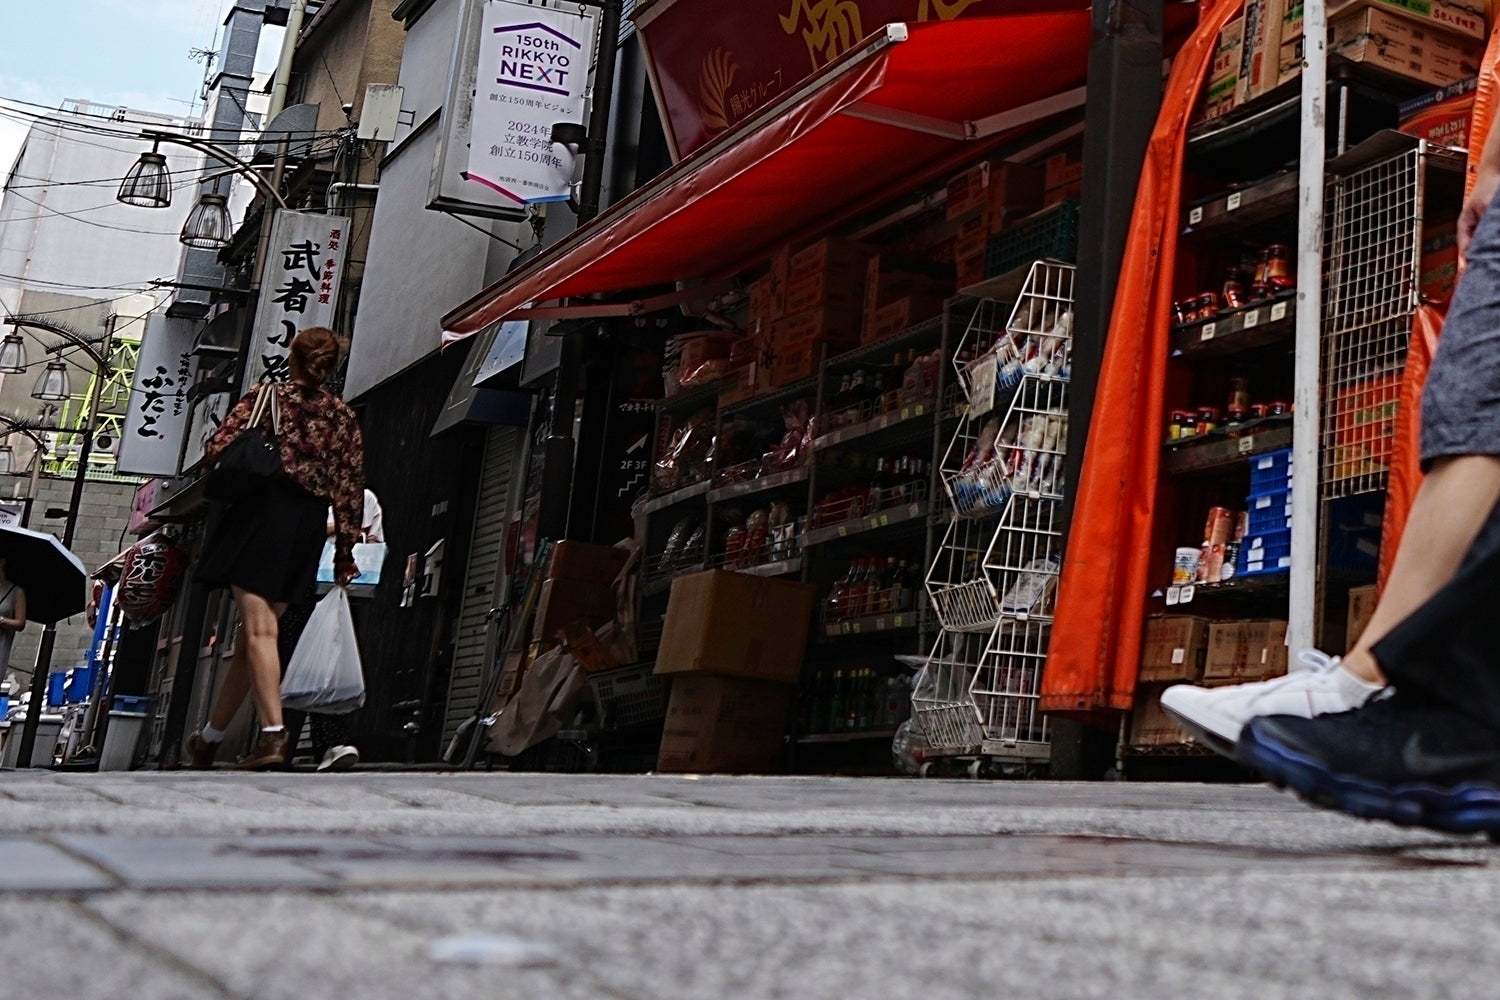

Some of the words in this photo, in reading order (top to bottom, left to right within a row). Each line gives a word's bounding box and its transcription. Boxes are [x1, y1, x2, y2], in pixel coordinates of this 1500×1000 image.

[516, 34, 559, 51] 150th
[502, 46, 570, 68] RIKKYO
[500, 60, 569, 86] NEXT
[489, 93, 573, 115] 創立150周年ビジョン
[504, 133, 554, 152] 立教学院
[489, 144, 563, 169] 創立150周年
[319, 259, 337, 305] 季節料理
[137, 366, 174, 438] ふたご
[620, 461, 633, 470] 2F
[635, 461, 647, 469] 3F
